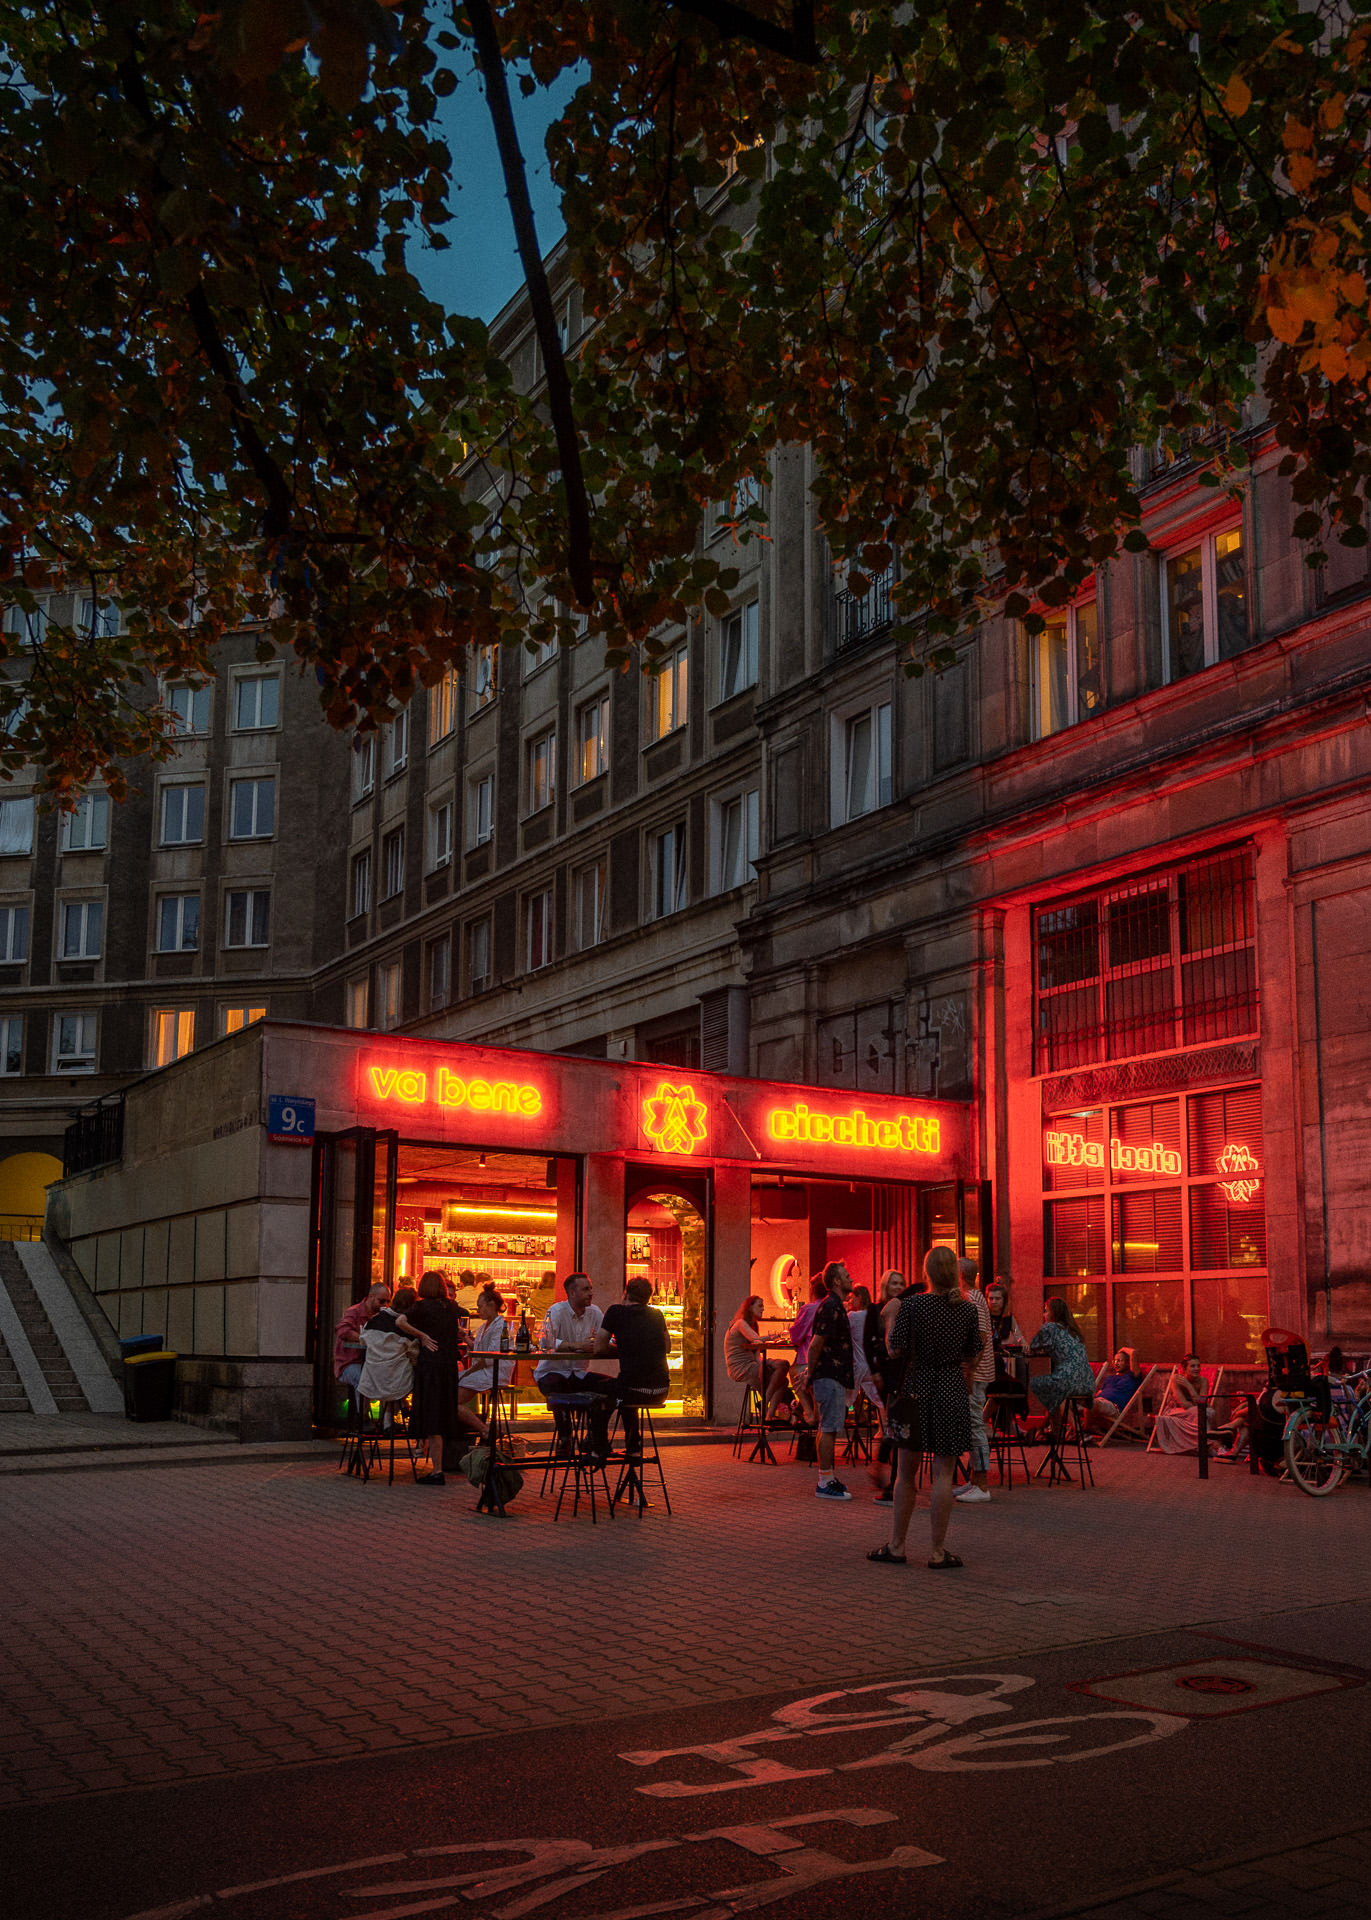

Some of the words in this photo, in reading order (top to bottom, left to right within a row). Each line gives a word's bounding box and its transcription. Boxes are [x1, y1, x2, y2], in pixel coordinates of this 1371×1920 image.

[370, 1067, 426, 1103] va
[438, 1067, 543, 1115] bene
[771, 1104, 941, 1153] cicchetti
